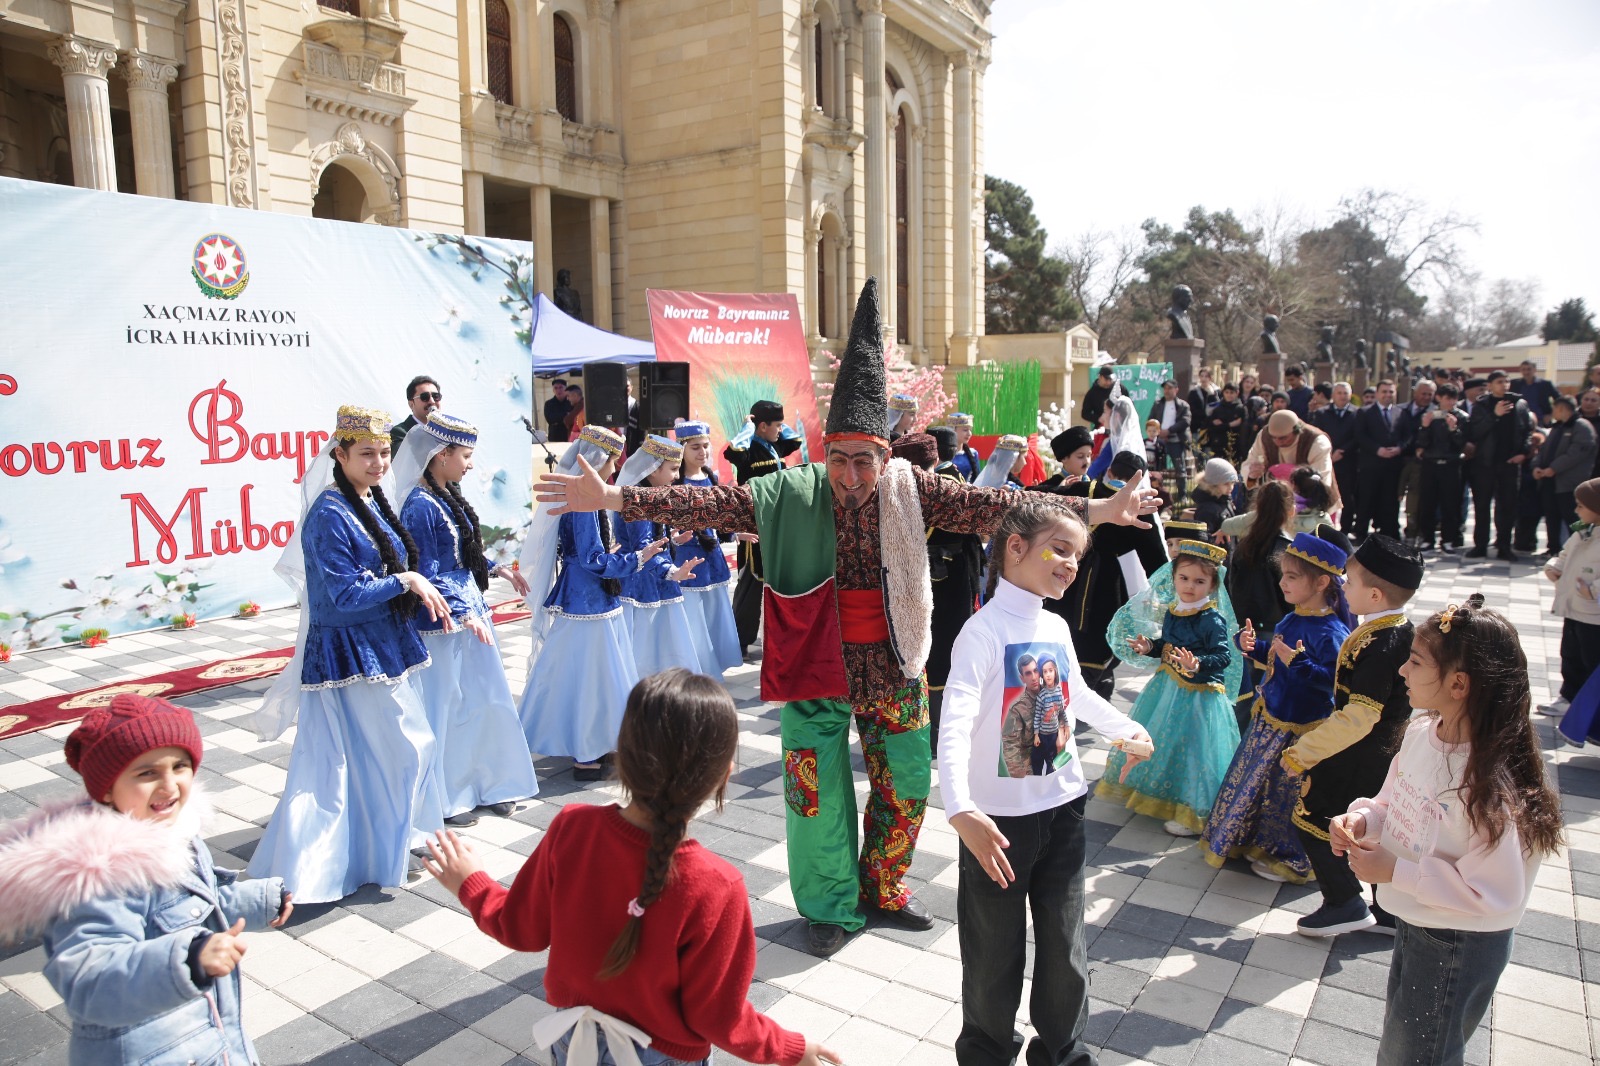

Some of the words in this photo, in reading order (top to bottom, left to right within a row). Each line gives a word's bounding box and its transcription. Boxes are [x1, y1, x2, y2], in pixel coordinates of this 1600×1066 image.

[142, 304, 230, 323] XAÇMAZ
[235, 308, 297, 324] RAYON
[664, 305, 709, 320] Novruz
[125, 325, 178, 344] İCRA
[182, 328, 311, 347] HAKİMİYYƏTİ
[687, 325, 771, 345] Mübarək!
[1139, 365, 1168, 385] BAHA
[188, 379, 335, 484] Bayr
[121, 484, 295, 568] Müba
[1391, 826, 1411, 849] LIFE
